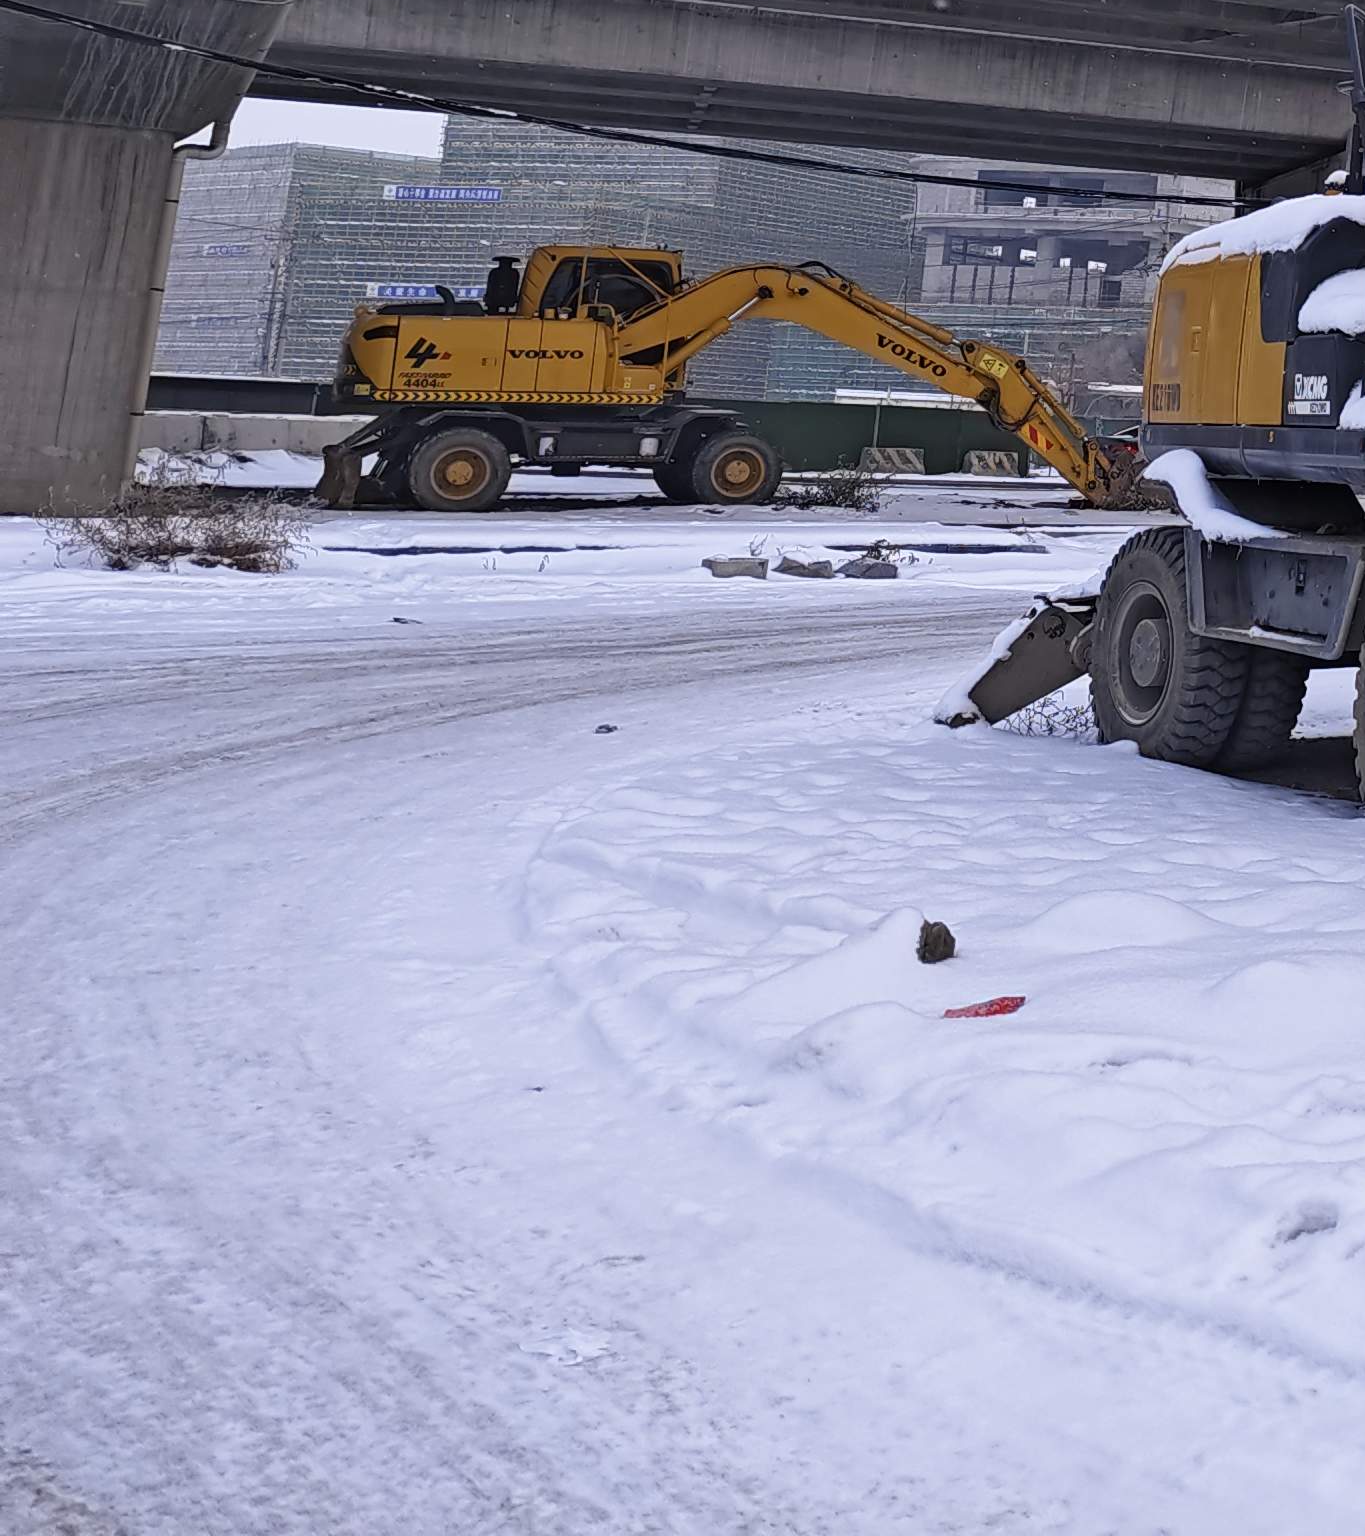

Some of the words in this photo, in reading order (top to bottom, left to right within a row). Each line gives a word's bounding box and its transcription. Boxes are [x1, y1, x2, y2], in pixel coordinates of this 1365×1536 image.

[507, 349, 584, 359] VOLVO
[876, 332, 947, 377] VOLVO
[1301, 375, 1328, 400] XCMG
